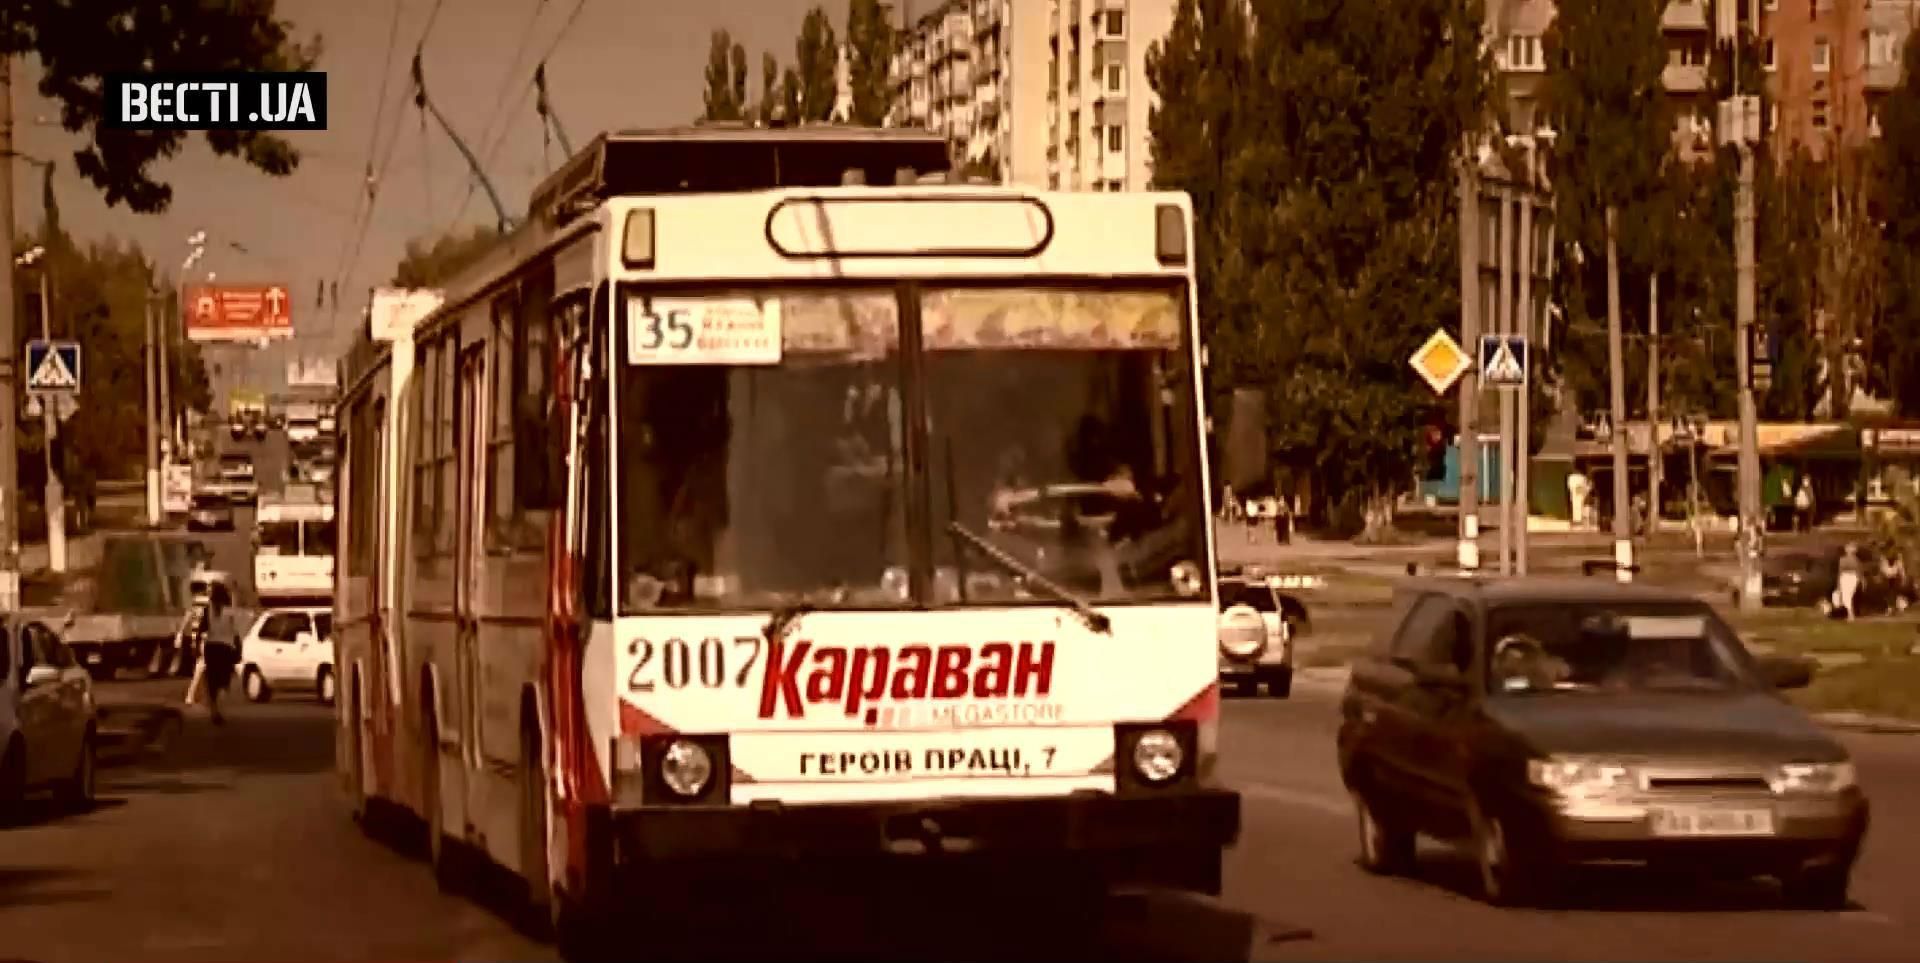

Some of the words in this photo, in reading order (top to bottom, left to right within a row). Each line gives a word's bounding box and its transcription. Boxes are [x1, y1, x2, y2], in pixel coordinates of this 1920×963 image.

[641, 308, 695, 350] 35
[627, 637, 761, 692] 2007
[758, 638, 1057, 719] Караван
[1042, 747, 1057, 769] 7
